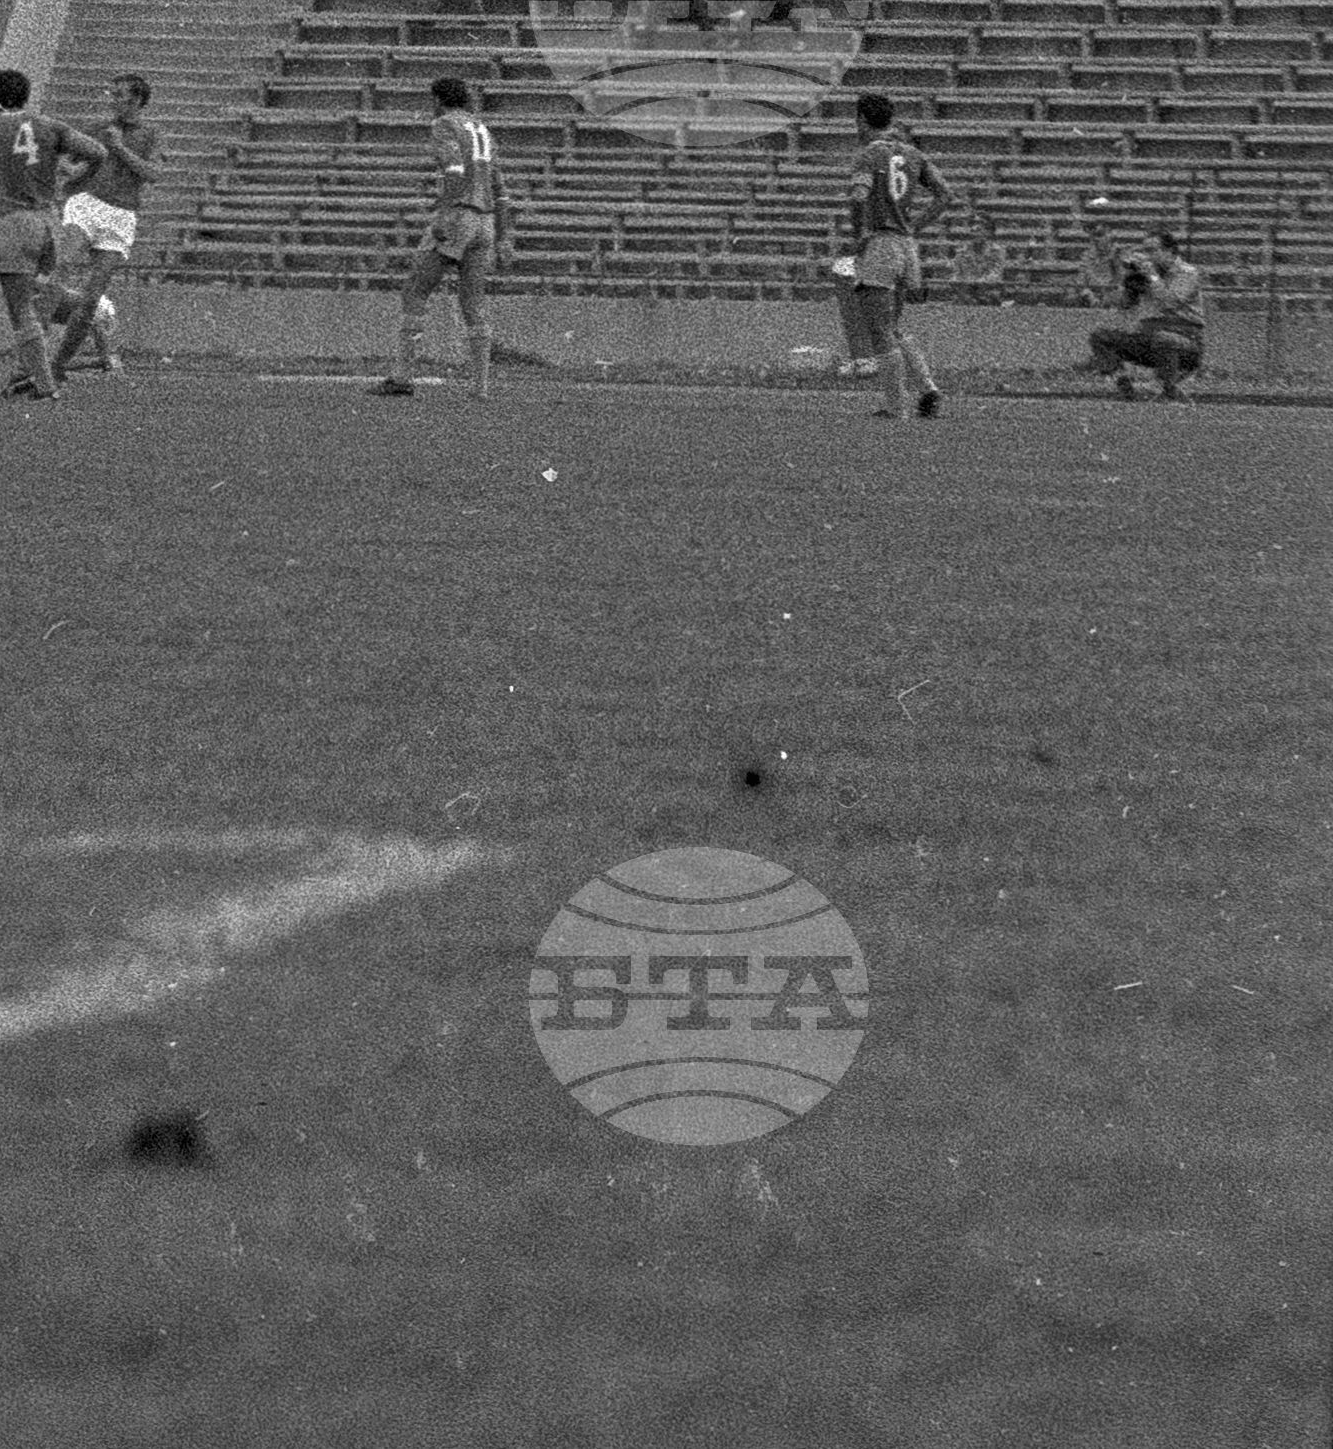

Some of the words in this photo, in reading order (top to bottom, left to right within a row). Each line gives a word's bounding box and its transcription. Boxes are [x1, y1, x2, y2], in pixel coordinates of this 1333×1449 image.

[13, 121, 39, 166] 4
[464, 121, 491, 162] 11
[889, 155, 908, 200] 6
